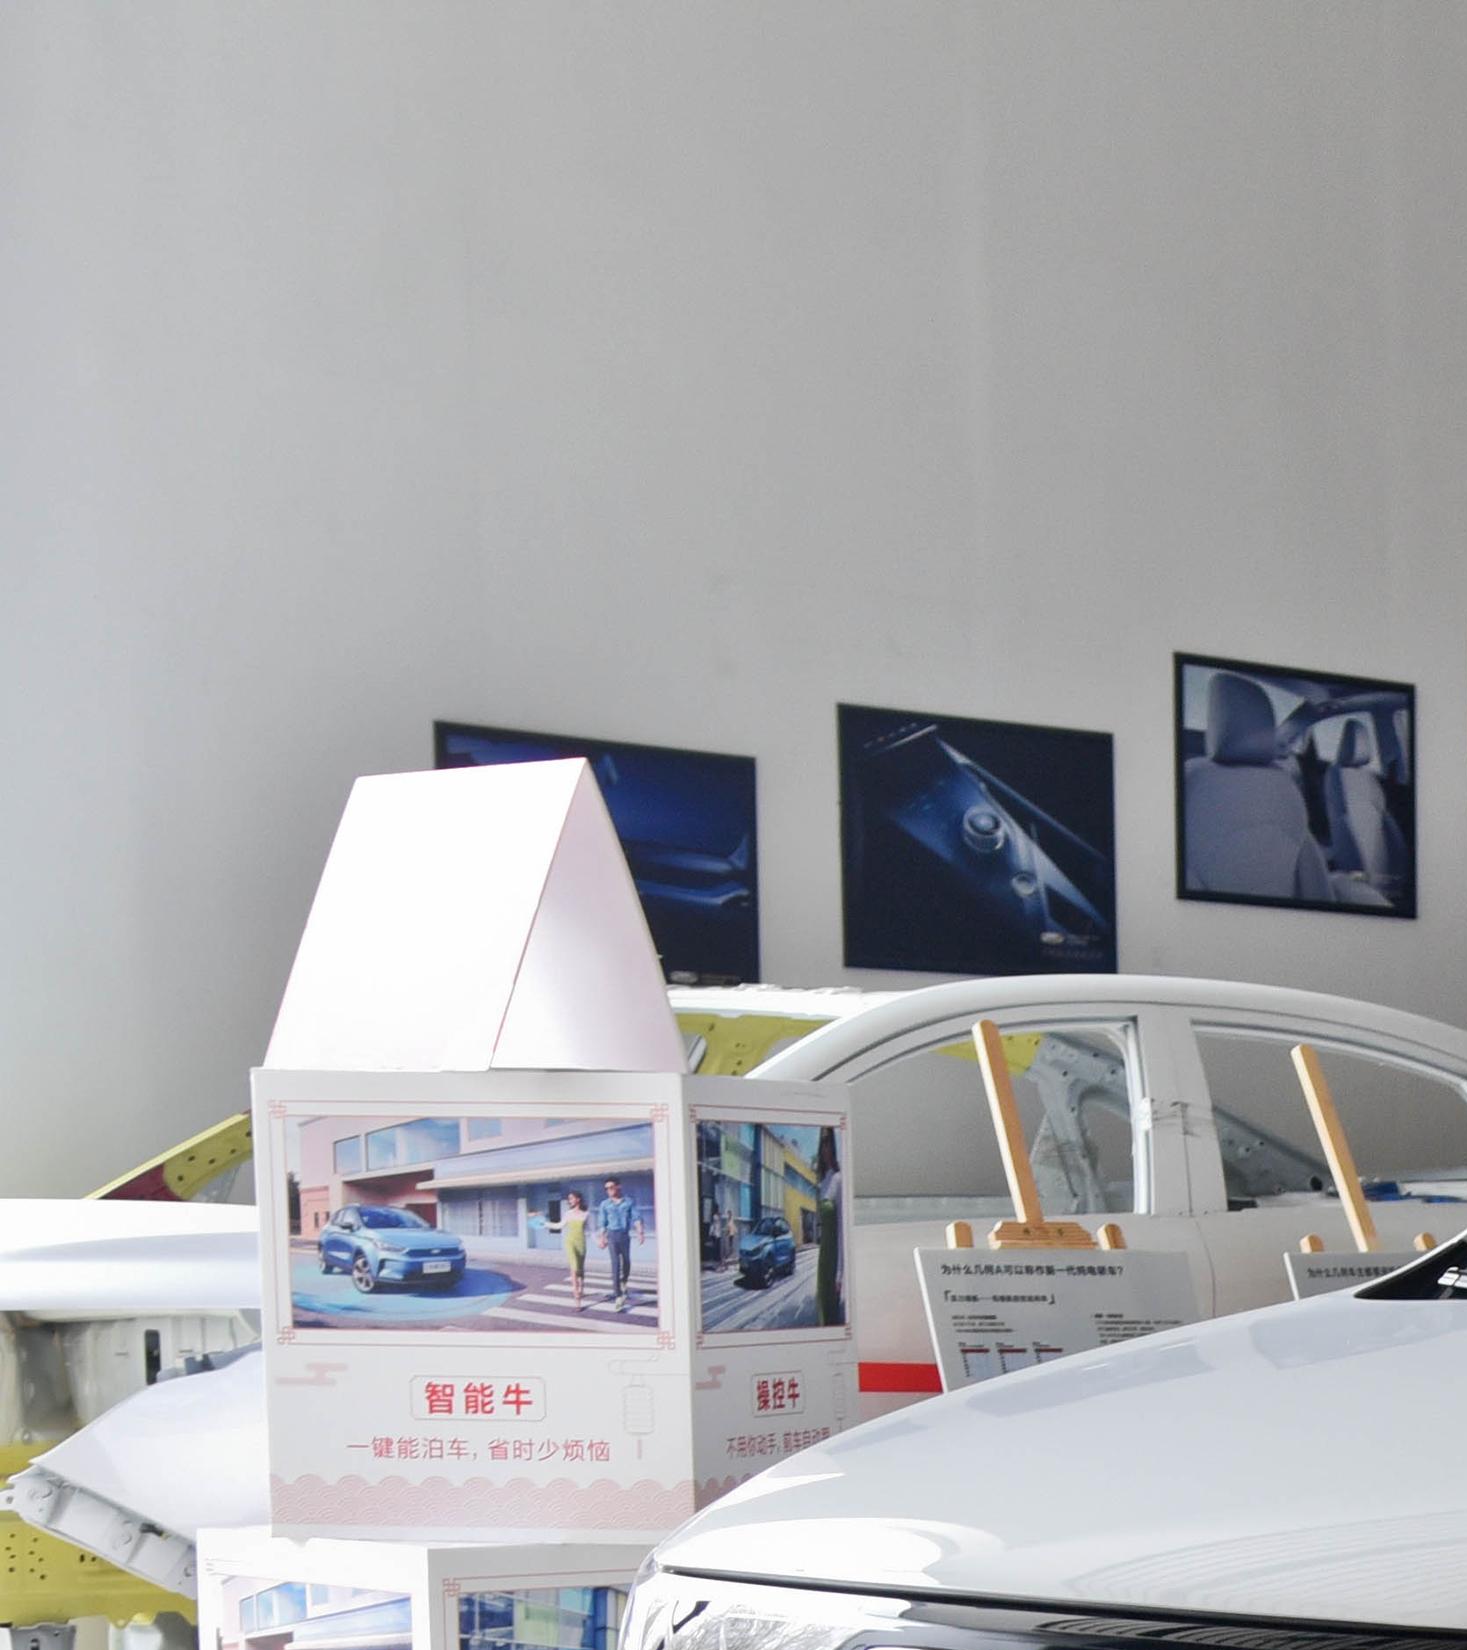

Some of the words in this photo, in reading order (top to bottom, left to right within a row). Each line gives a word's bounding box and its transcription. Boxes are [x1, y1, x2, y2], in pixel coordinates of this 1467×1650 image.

[424, 1380, 534, 1416] 智能牛
[757, 1376, 801, 1412] 操控牛
